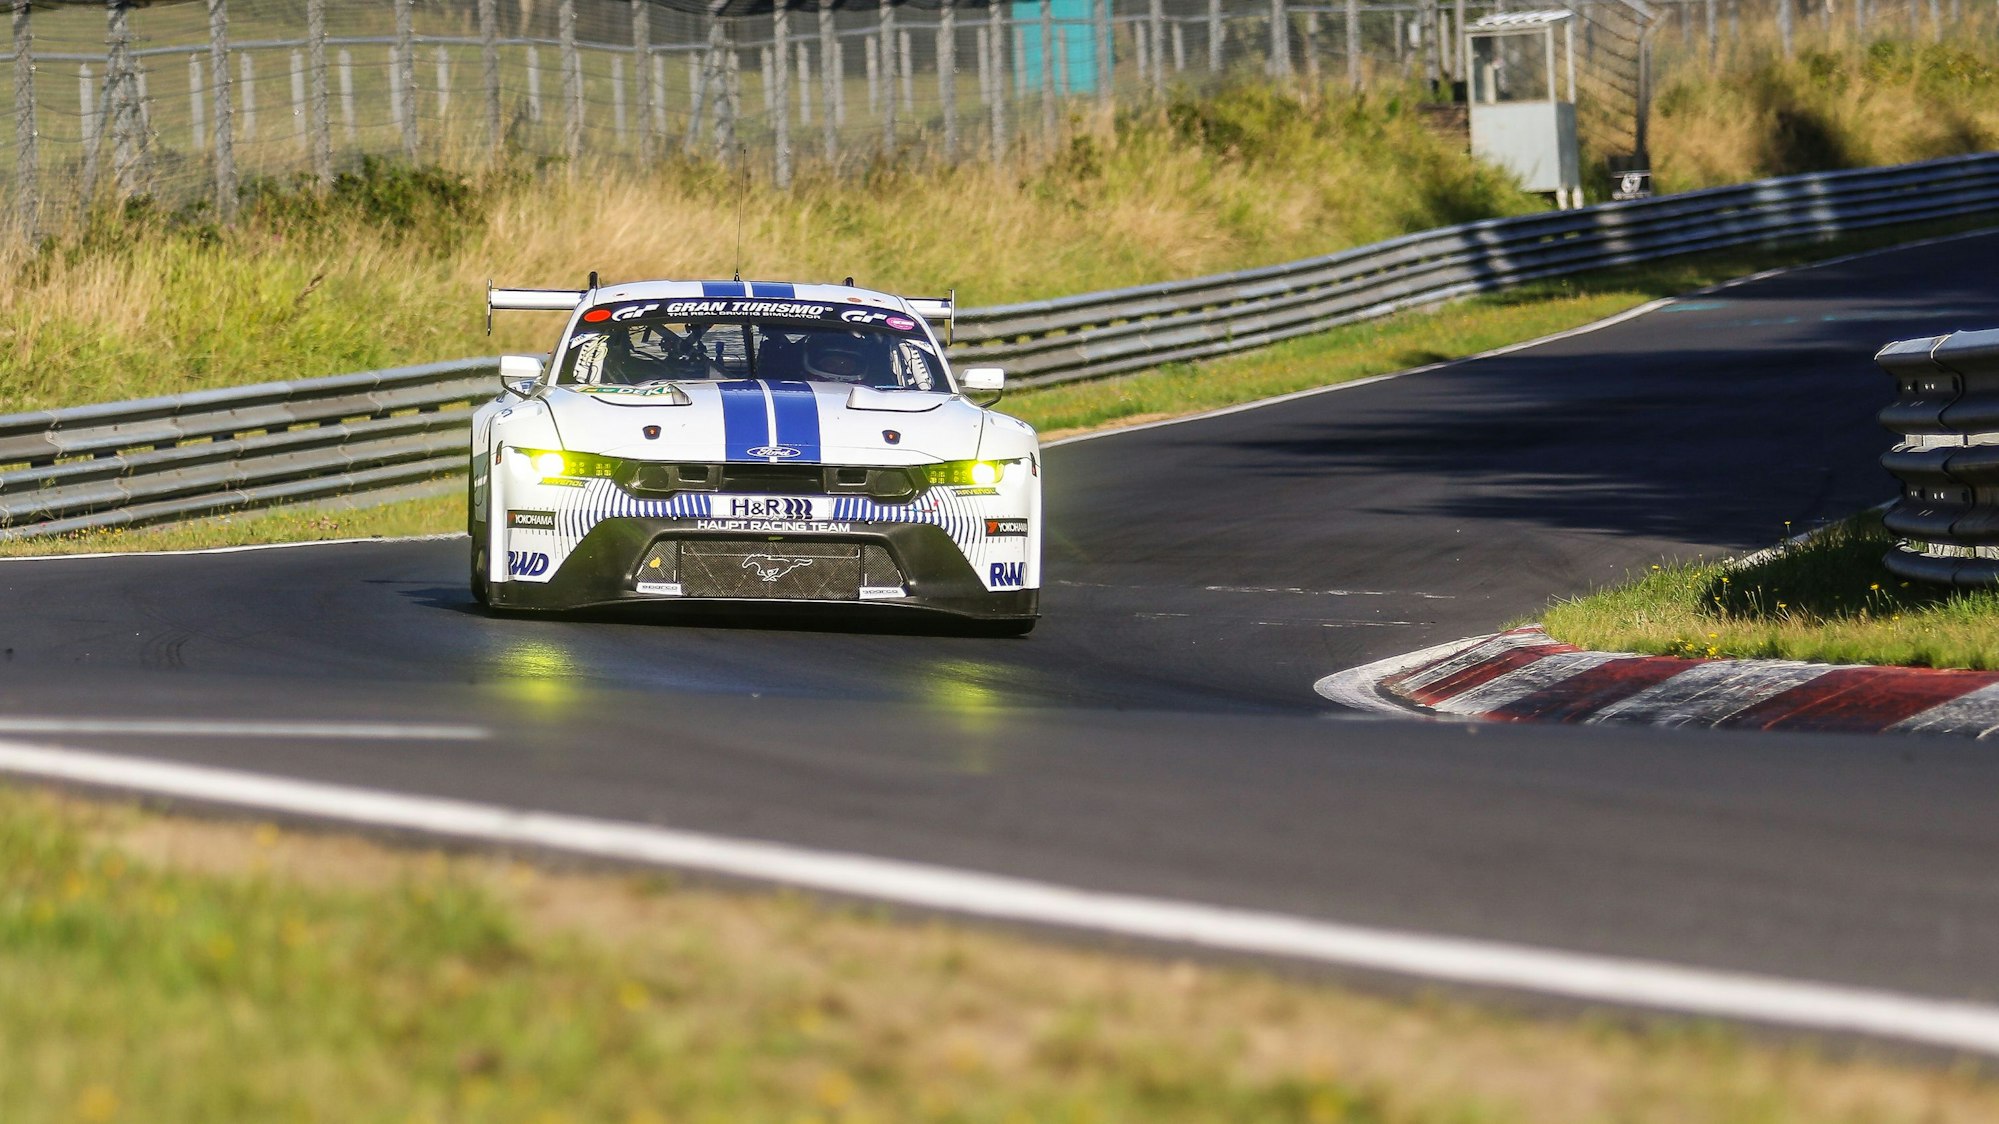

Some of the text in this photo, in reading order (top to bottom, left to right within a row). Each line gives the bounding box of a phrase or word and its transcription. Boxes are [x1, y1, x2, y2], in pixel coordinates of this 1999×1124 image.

[667, 301, 825, 315] GRAN TURISMO
[762, 312, 821, 320] SIMULATOR
[757, 448, 791, 456] Ford
[732, 498, 779, 516] H&R
[515, 513, 554, 526] YOKOHAMA
[698, 520, 851, 533] HAUPT RACING TEAM
